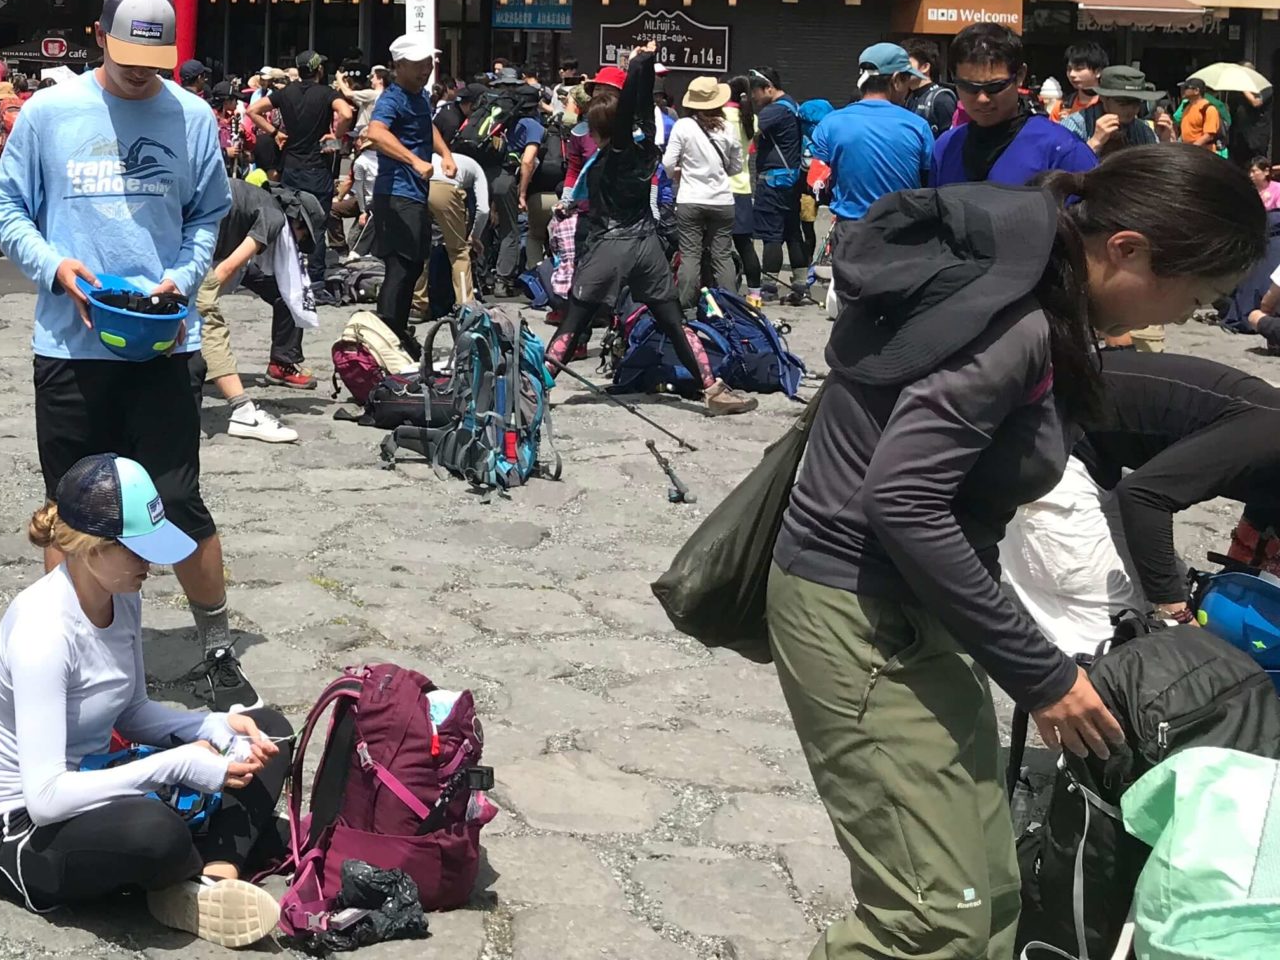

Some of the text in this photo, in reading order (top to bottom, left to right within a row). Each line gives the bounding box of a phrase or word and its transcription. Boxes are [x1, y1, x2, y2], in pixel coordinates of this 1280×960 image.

[960, 8, 1019, 24] Welcome
[68, 49, 88, 58] café
[66, 159, 127, 178] trans
[142, 181, 172, 193] relay
